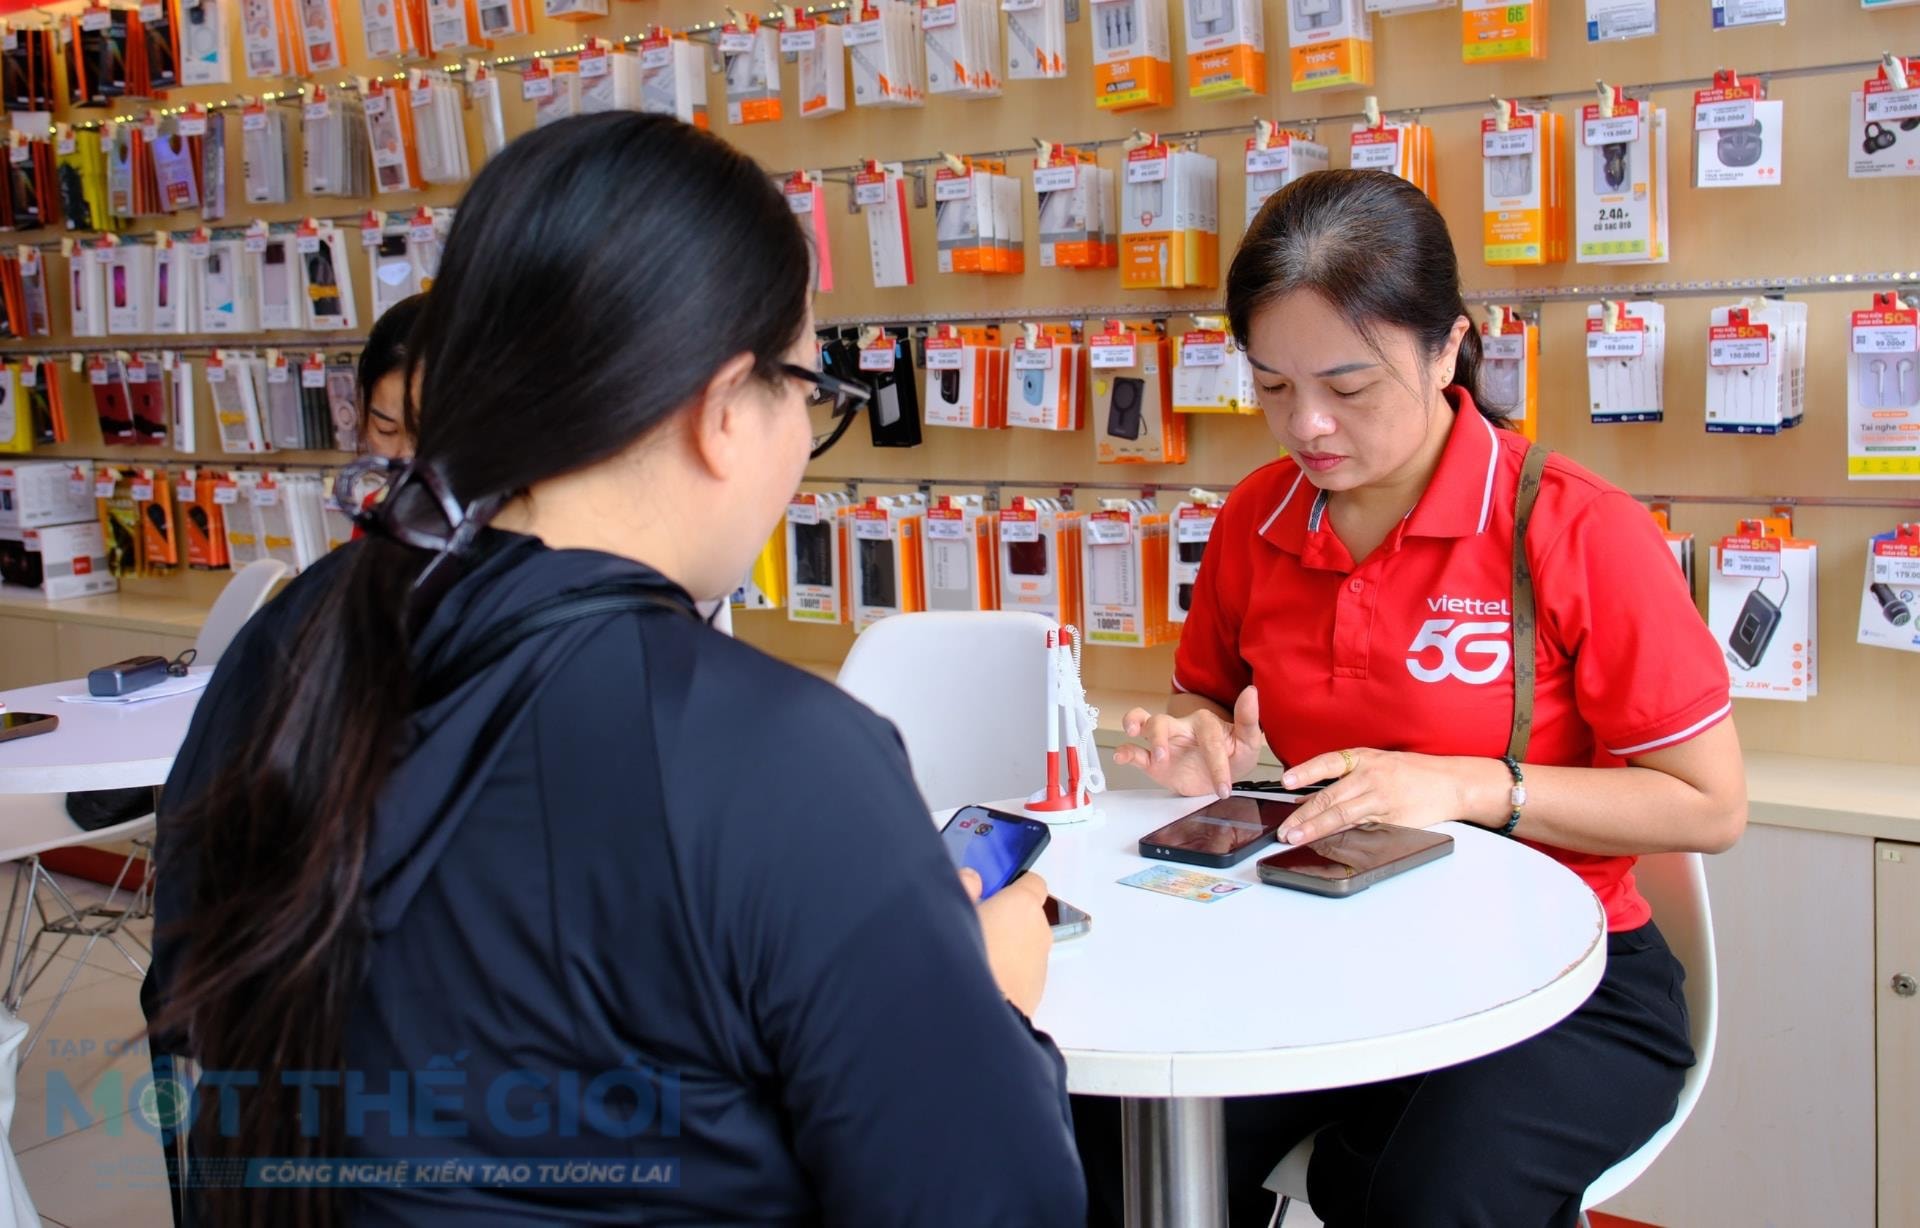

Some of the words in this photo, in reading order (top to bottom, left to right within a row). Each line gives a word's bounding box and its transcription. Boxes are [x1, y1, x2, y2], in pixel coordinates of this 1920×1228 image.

[1860, 423, 1873, 431] Tai
[1875, 423, 1897, 432] nghe
[1427, 594, 1511, 616] viettel
[1405, 618, 1511, 685] 5G
